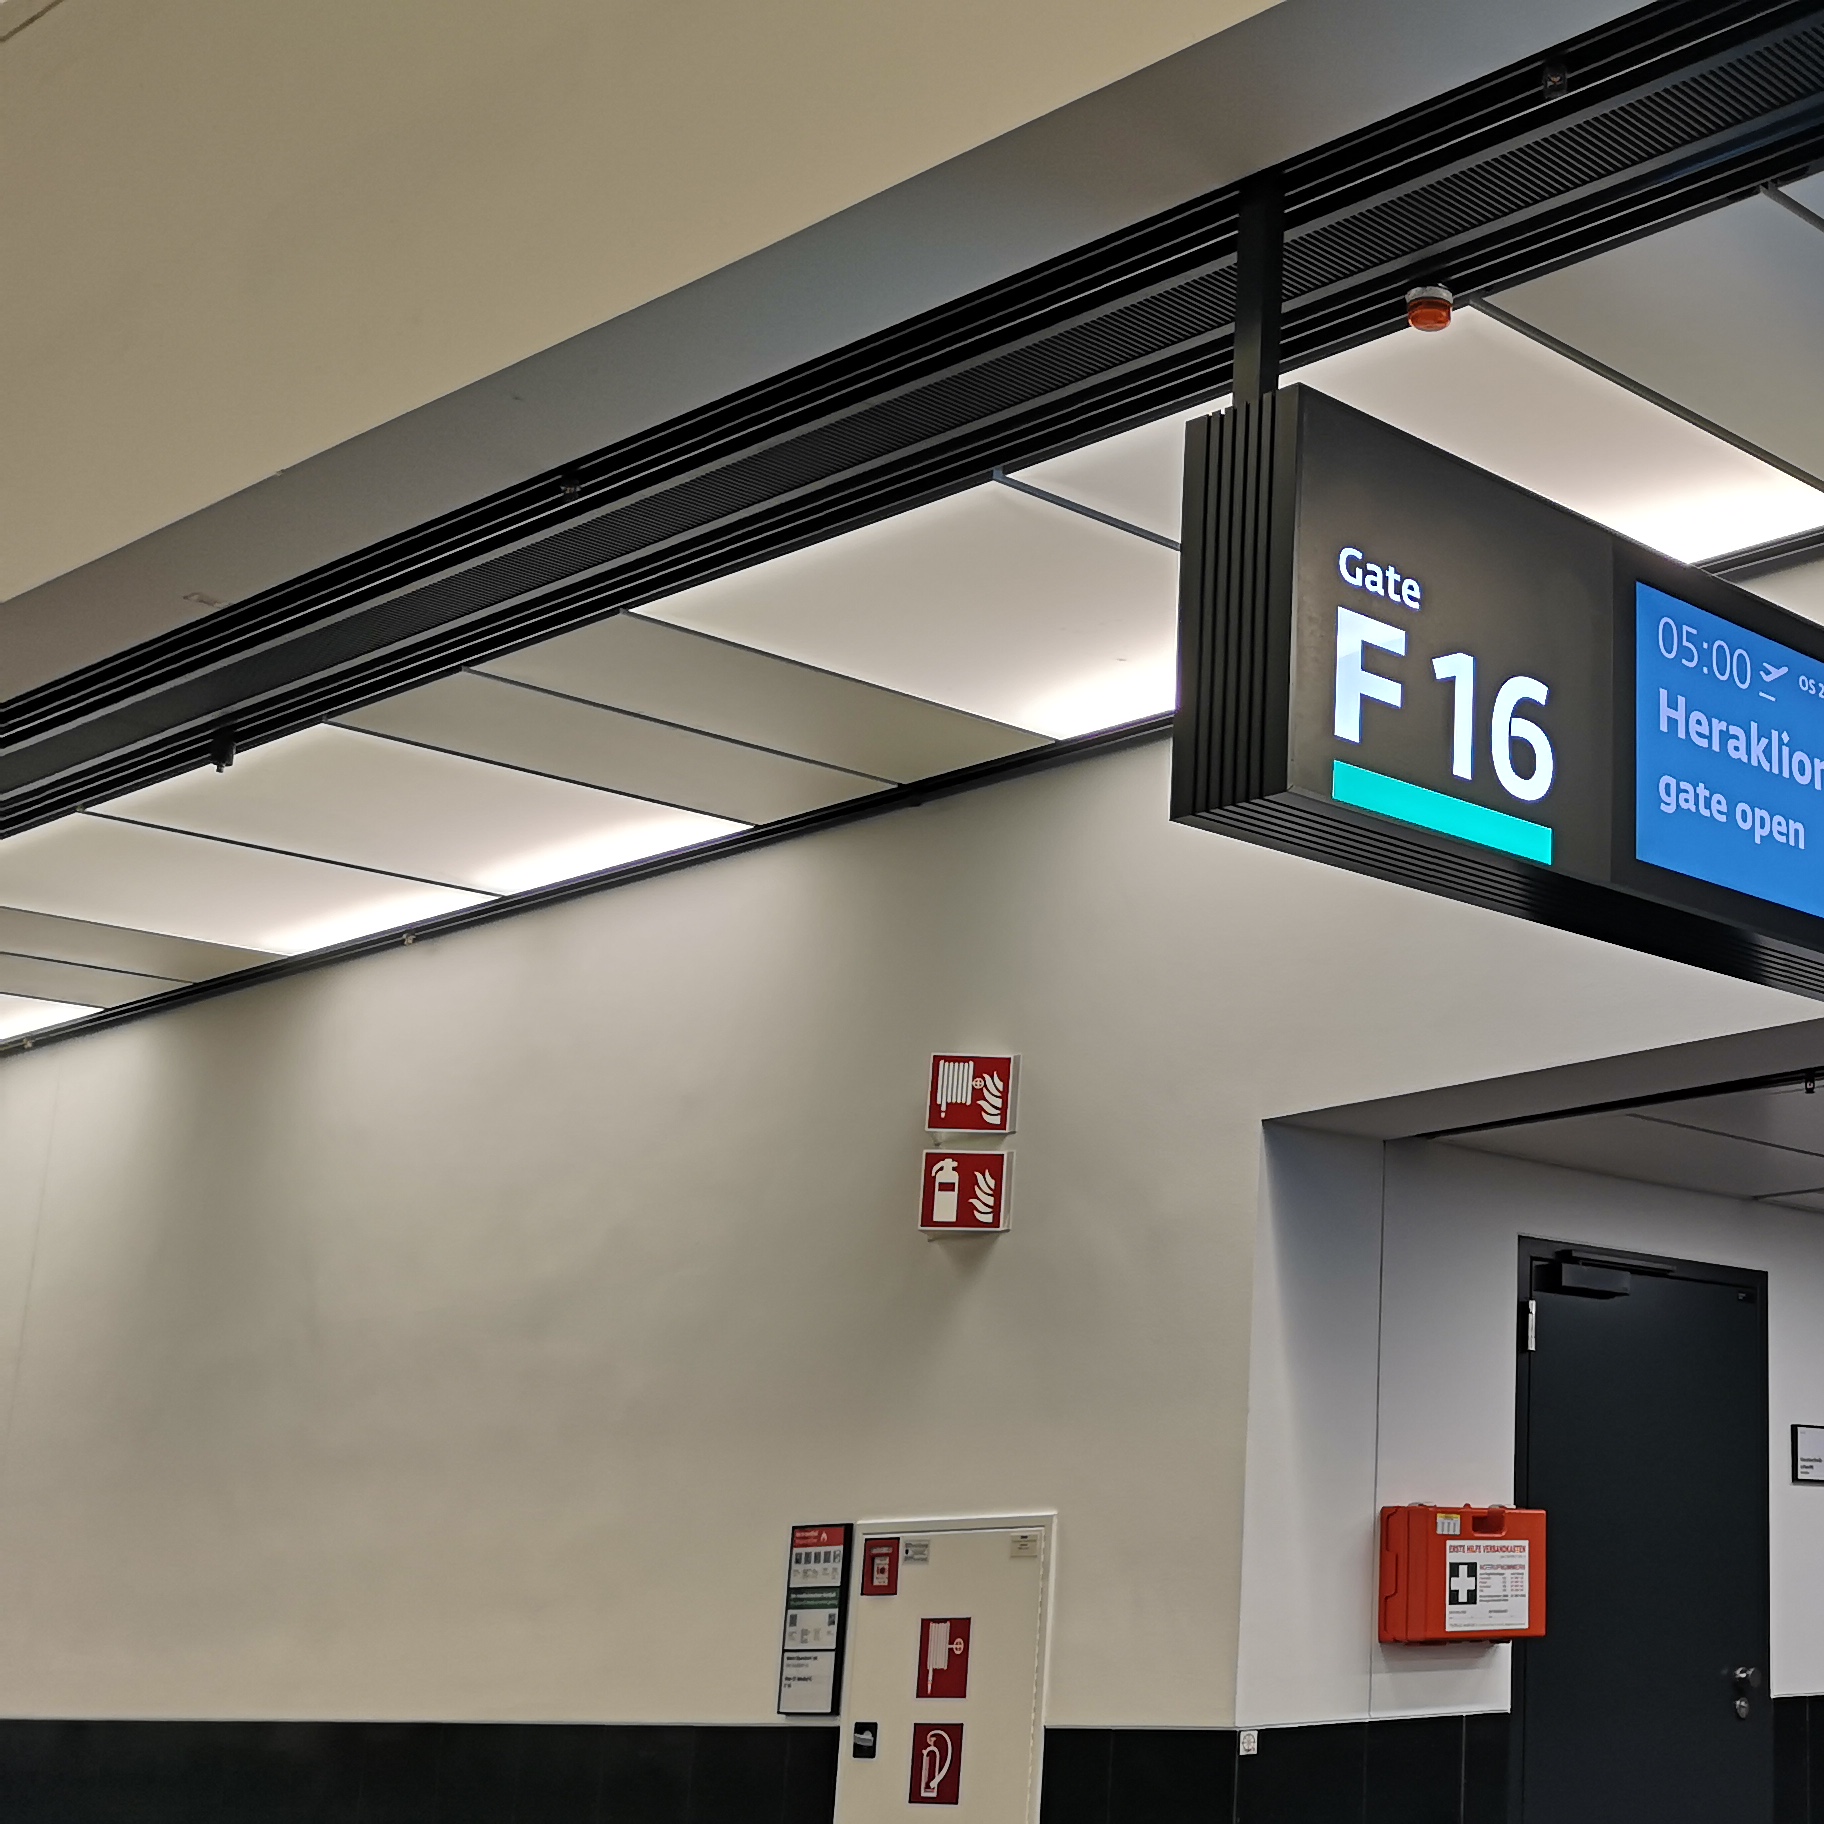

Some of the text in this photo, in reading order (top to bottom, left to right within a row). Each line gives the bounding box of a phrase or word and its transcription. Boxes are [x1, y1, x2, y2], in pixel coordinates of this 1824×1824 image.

[1337, 546, 1422, 611] Gate
[1657, 615, 1752, 691] 05:00
[1798, 675, 1817, 696] OS
[1333, 605, 1555, 803] F 16
[1658, 774, 1806, 851] gate open
